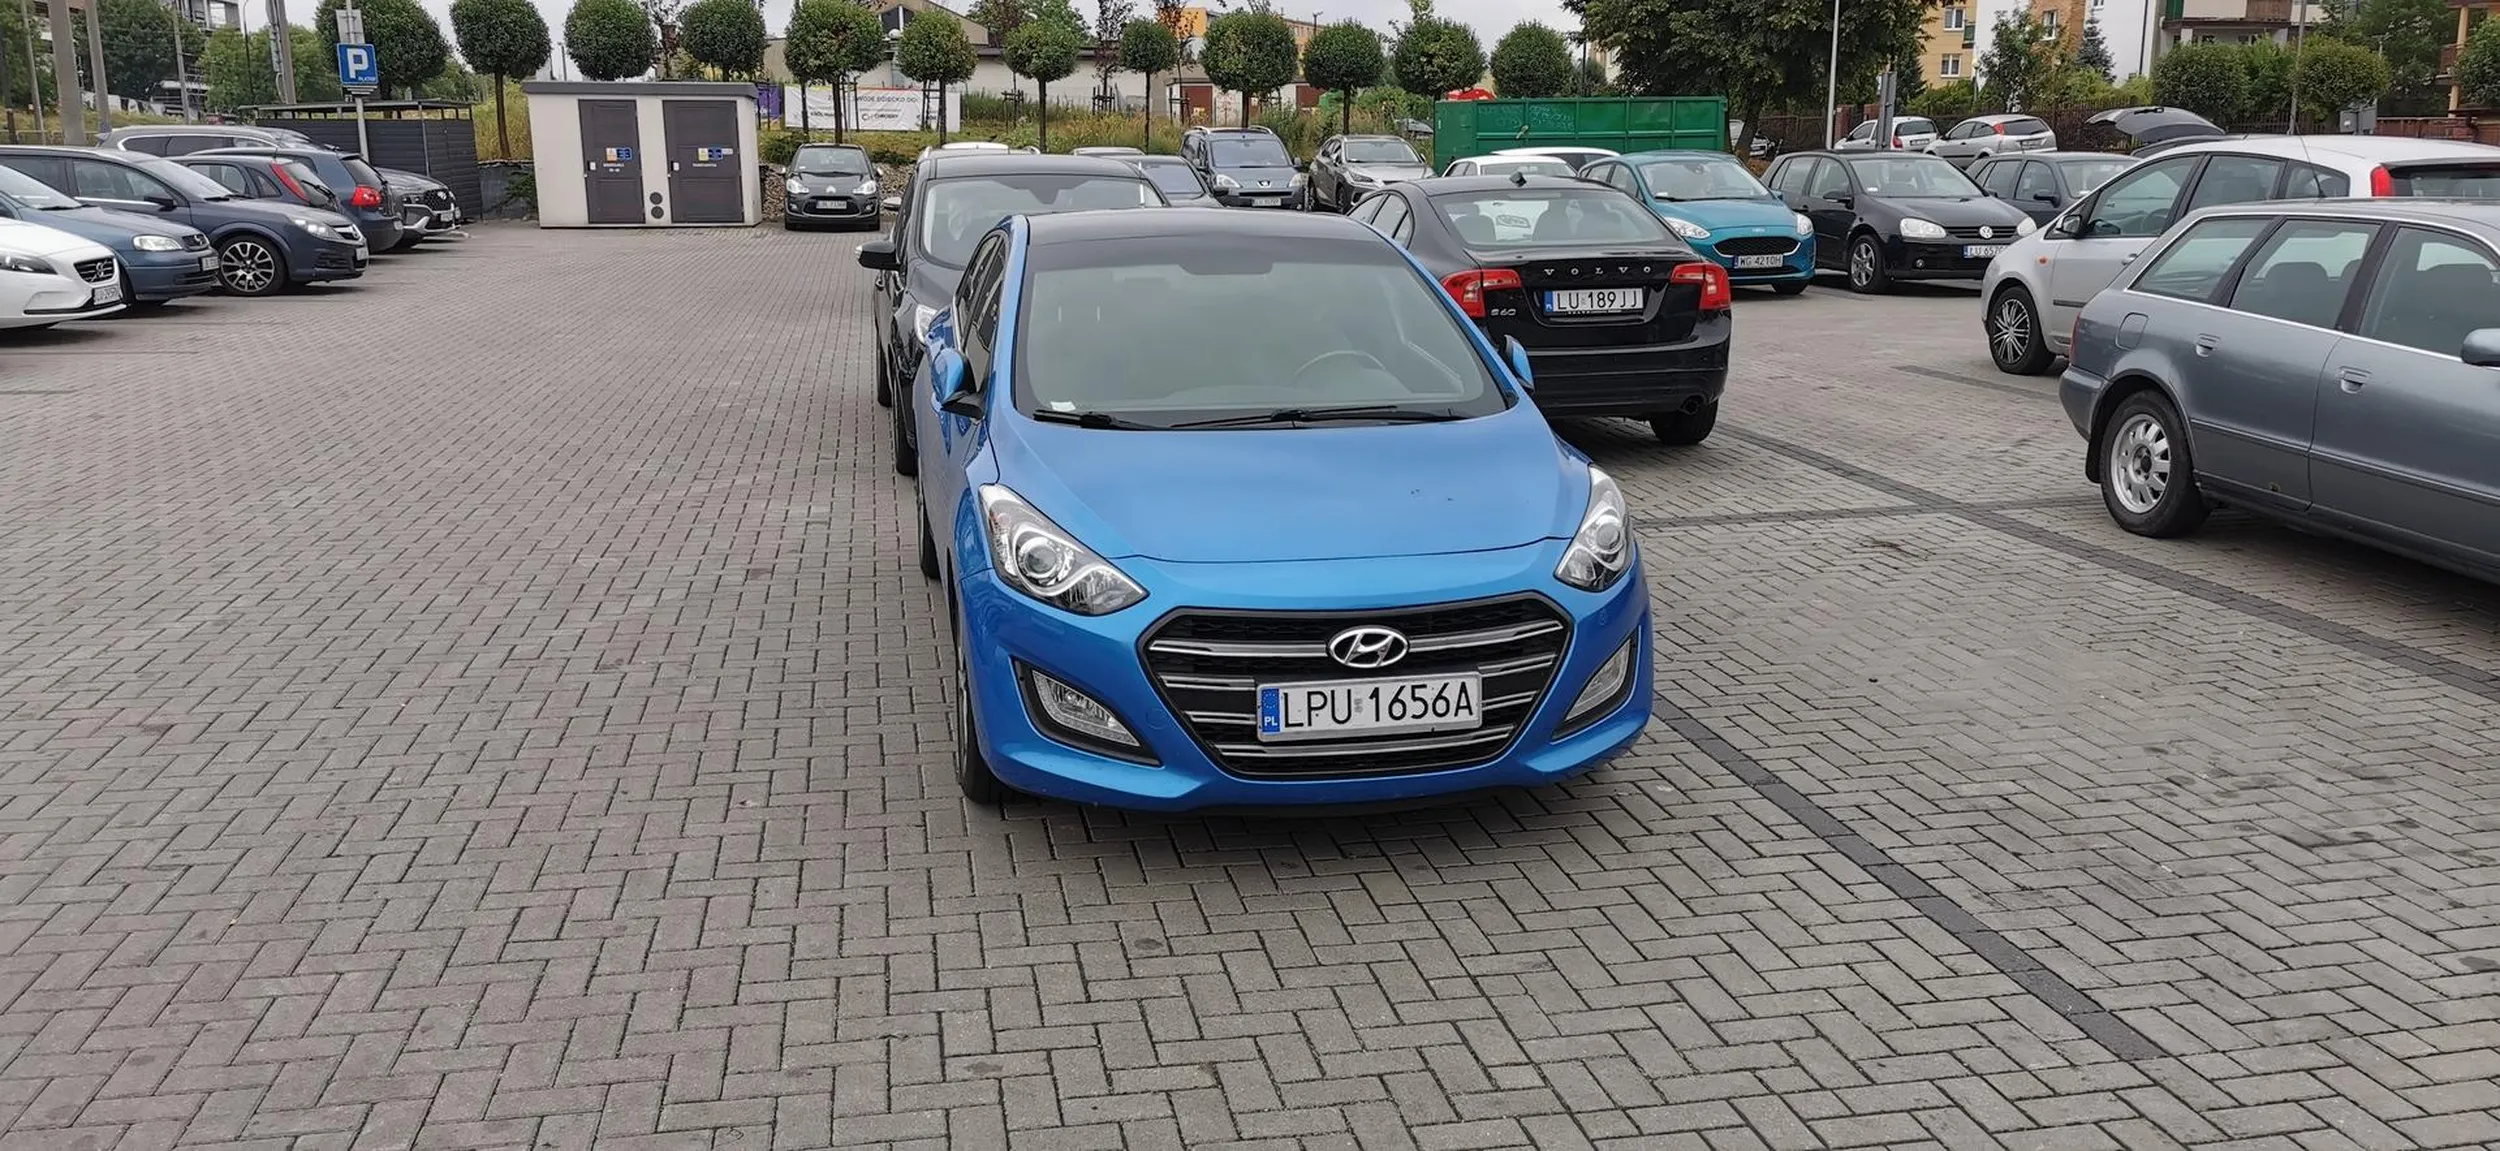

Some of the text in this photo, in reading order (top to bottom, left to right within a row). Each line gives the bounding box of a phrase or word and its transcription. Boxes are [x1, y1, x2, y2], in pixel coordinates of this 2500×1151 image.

[347, 48, 368, 79] P
[1544, 266, 1651, 276] VOLVO
[1557, 290, 1638, 310] LU 189JJ
[1491, 308, 1517, 316] S60
[1283, 681, 1474, 728] LPU 1656A
[1264, 716, 1278, 726] PL
